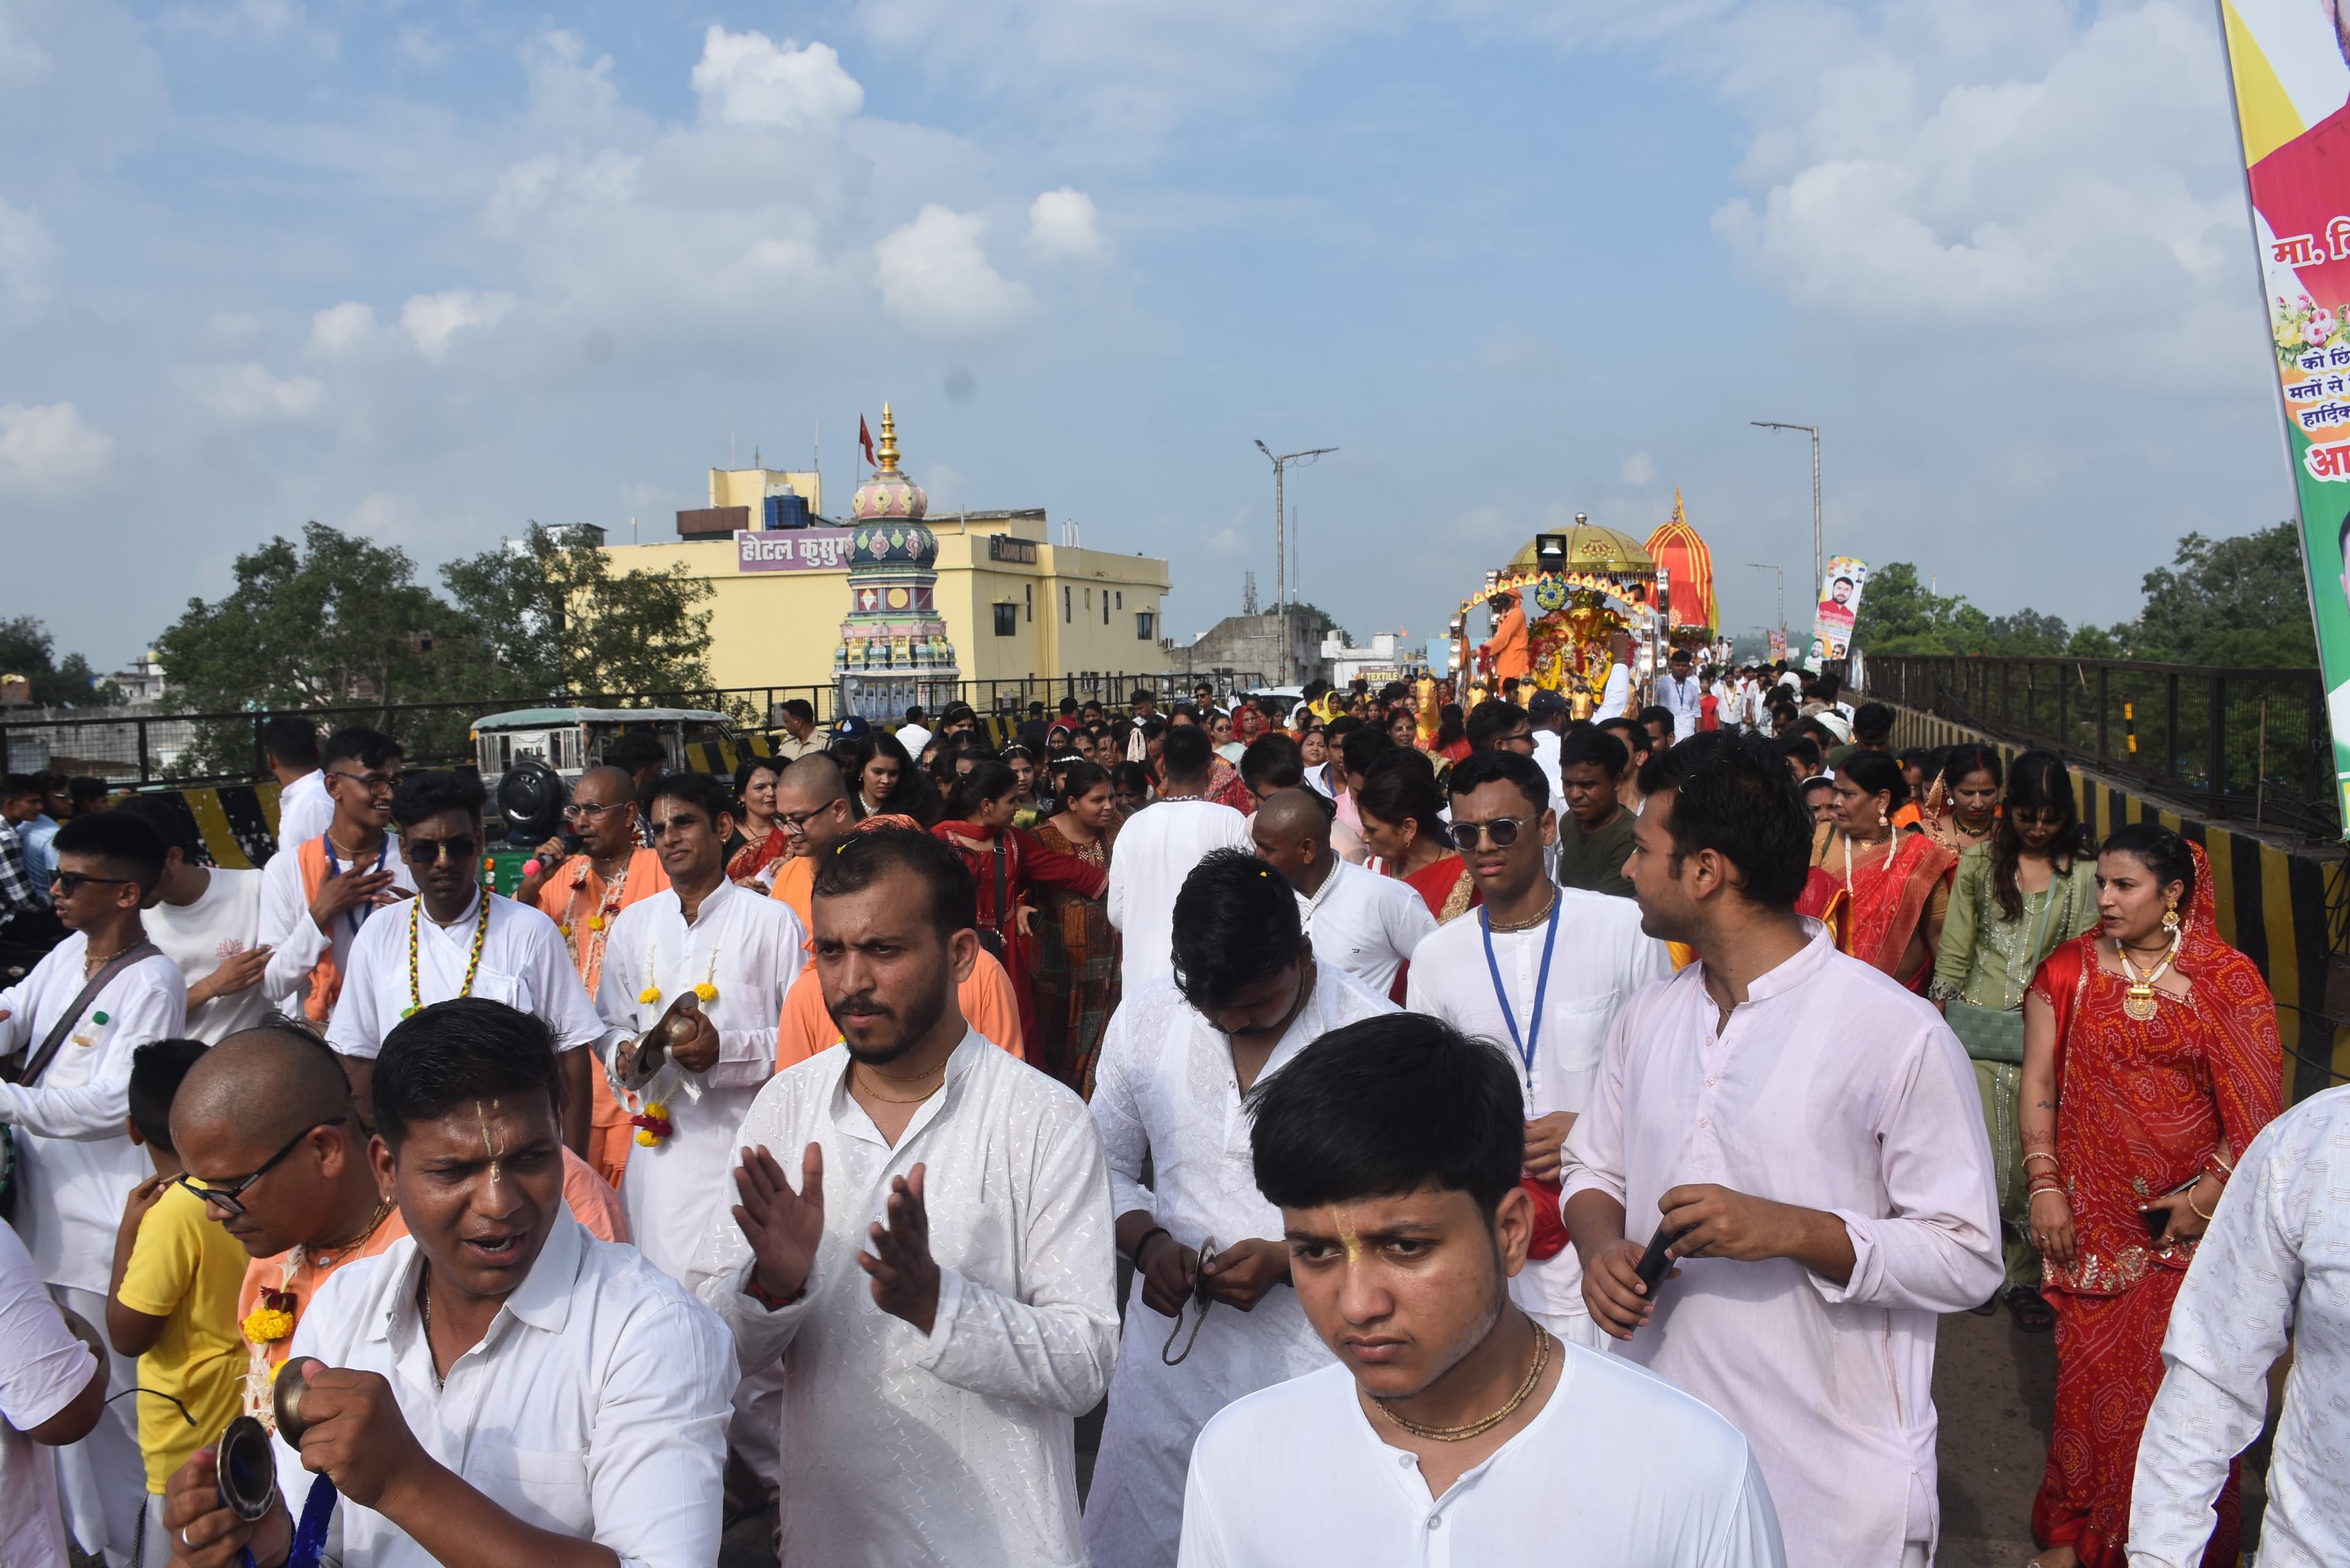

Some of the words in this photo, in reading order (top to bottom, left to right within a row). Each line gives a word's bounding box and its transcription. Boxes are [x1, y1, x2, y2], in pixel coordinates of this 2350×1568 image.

[2270, 236, 2323, 265] मा.
[2301, 351, 2325, 370] को
[2288, 378, 2322, 399] मतों
[2327, 375, 2343, 394] से
[740, 534, 794, 561] होटल
[1366, 671, 1398, 681] TEXTILE
